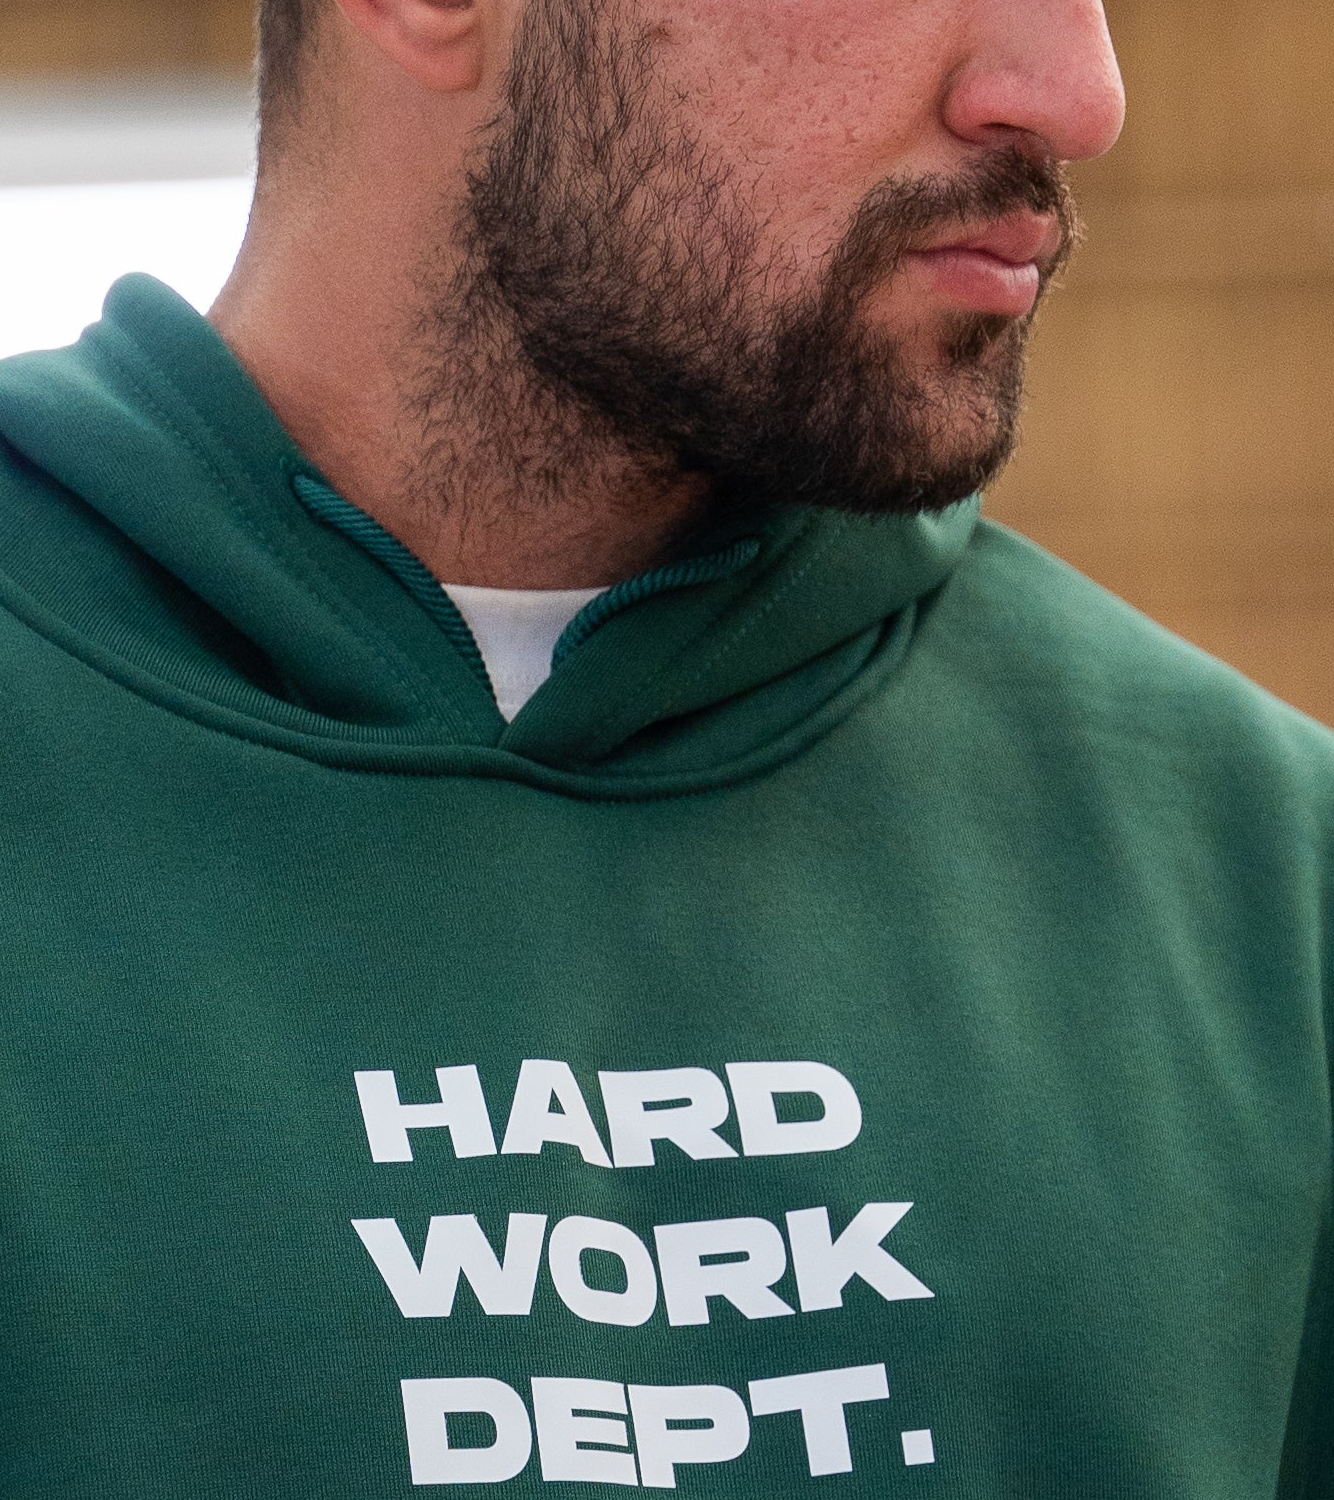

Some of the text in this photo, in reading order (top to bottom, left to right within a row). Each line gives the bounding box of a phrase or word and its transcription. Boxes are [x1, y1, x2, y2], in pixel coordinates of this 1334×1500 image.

[353, 1058, 863, 1169] HARD
[350, 1201, 936, 1327] WORK
[399, 1362, 936, 1489] DEPT.
